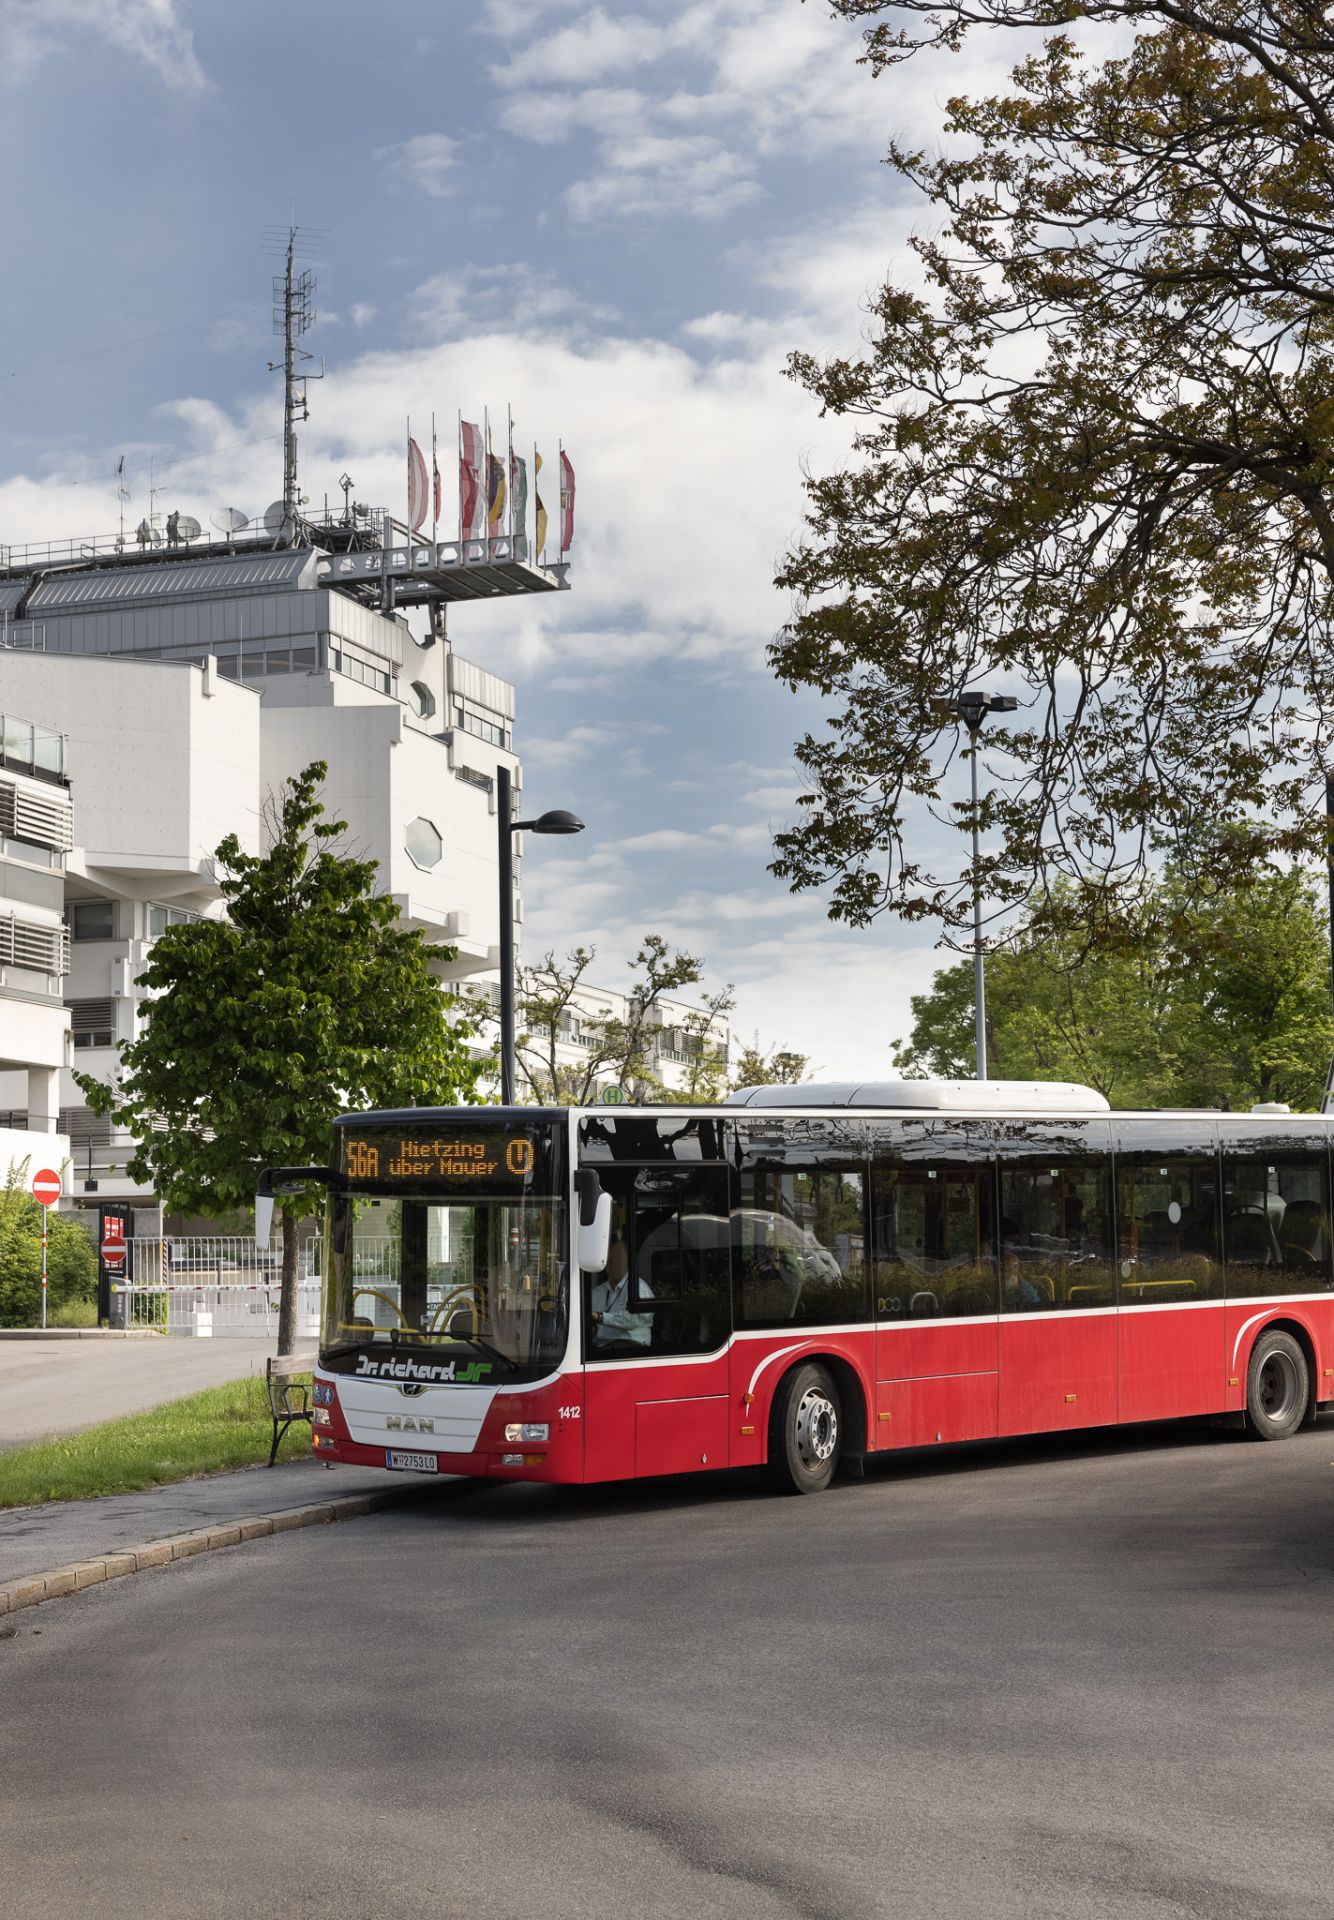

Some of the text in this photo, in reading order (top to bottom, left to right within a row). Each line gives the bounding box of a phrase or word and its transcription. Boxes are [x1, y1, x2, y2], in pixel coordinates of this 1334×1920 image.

[401, 1140, 485, 1159] Hietzing
[347, 1141, 379, 1177] 56A
[390, 1158, 498, 1175] über Mauer
[558, 1405, 581, 1419] 1412
[386, 1415, 434, 1433] MAN
